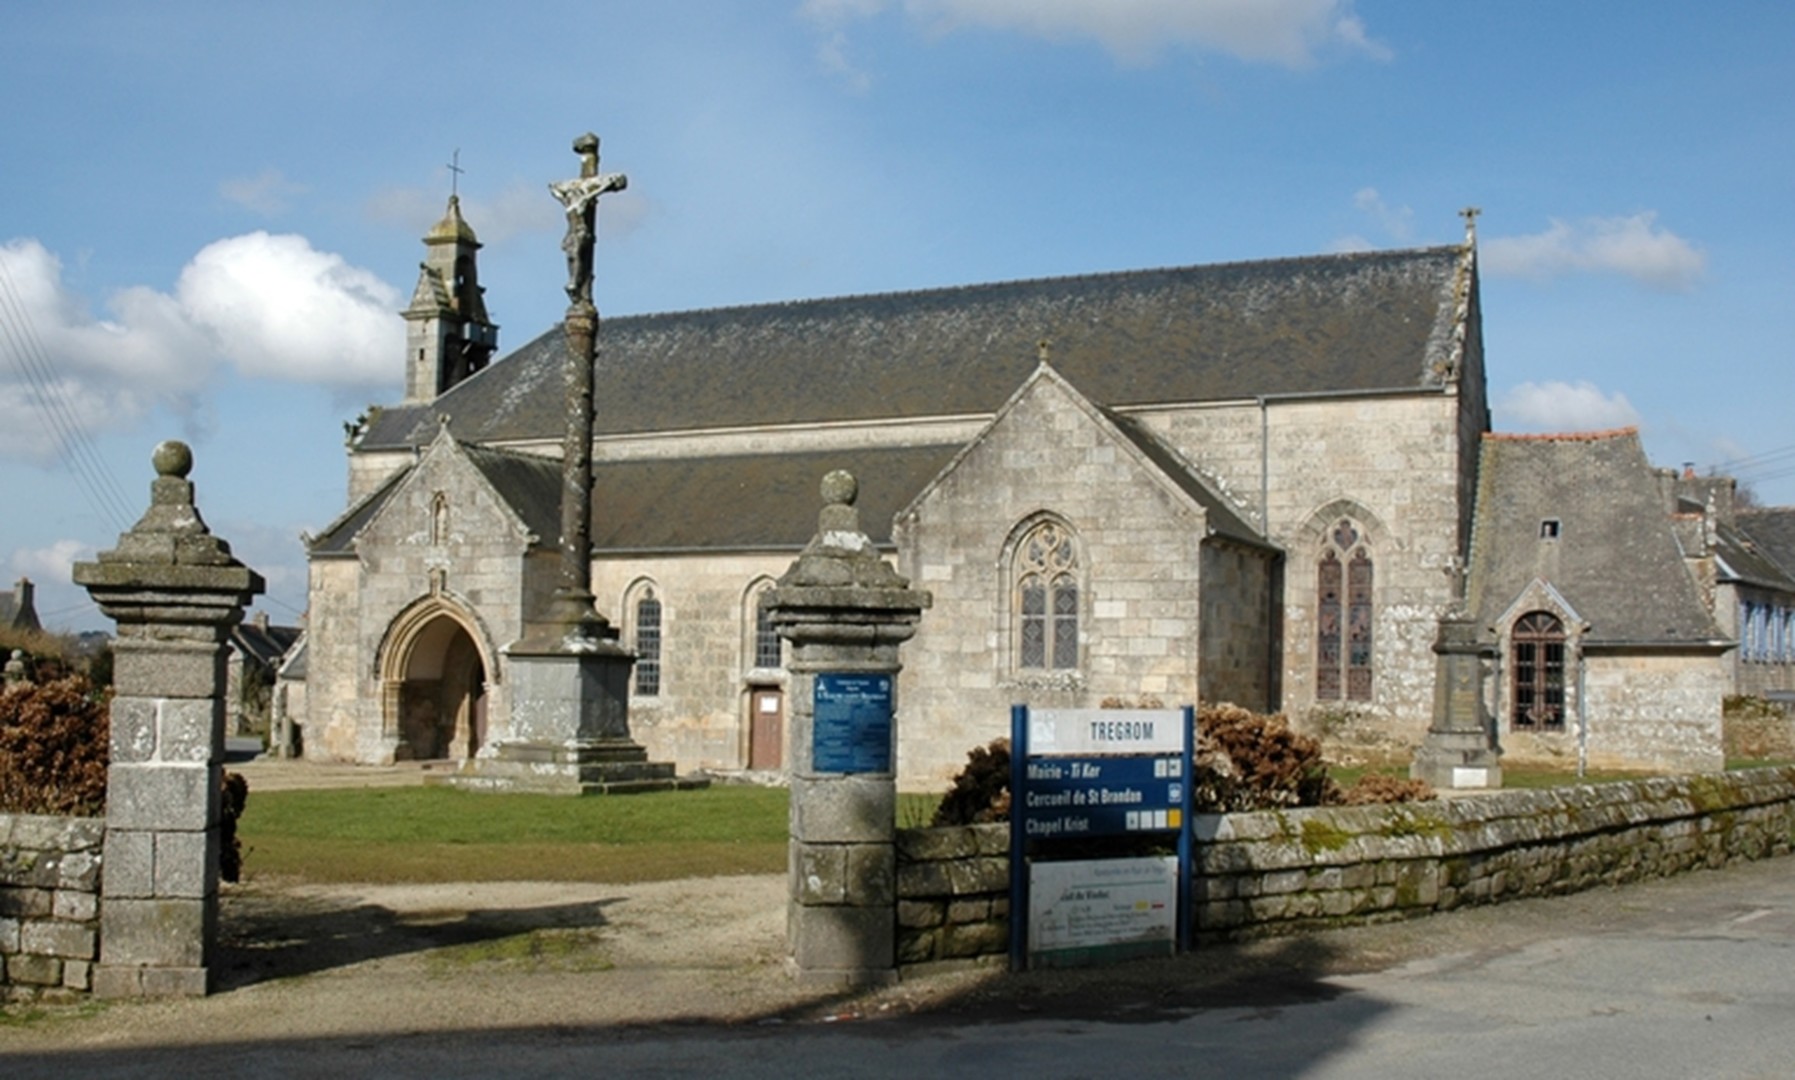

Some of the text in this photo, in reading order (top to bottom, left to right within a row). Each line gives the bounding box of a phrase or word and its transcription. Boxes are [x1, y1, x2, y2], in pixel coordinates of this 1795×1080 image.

[1091, 721, 1154, 740] TREGROM
[1027, 763, 1062, 779] Mairie
[1026, 789, 1071, 807] Cercueil
[1073, 789, 1085, 805] de
[1088, 788, 1099, 805] St
[1026, 818, 1062, 837] Chapel
